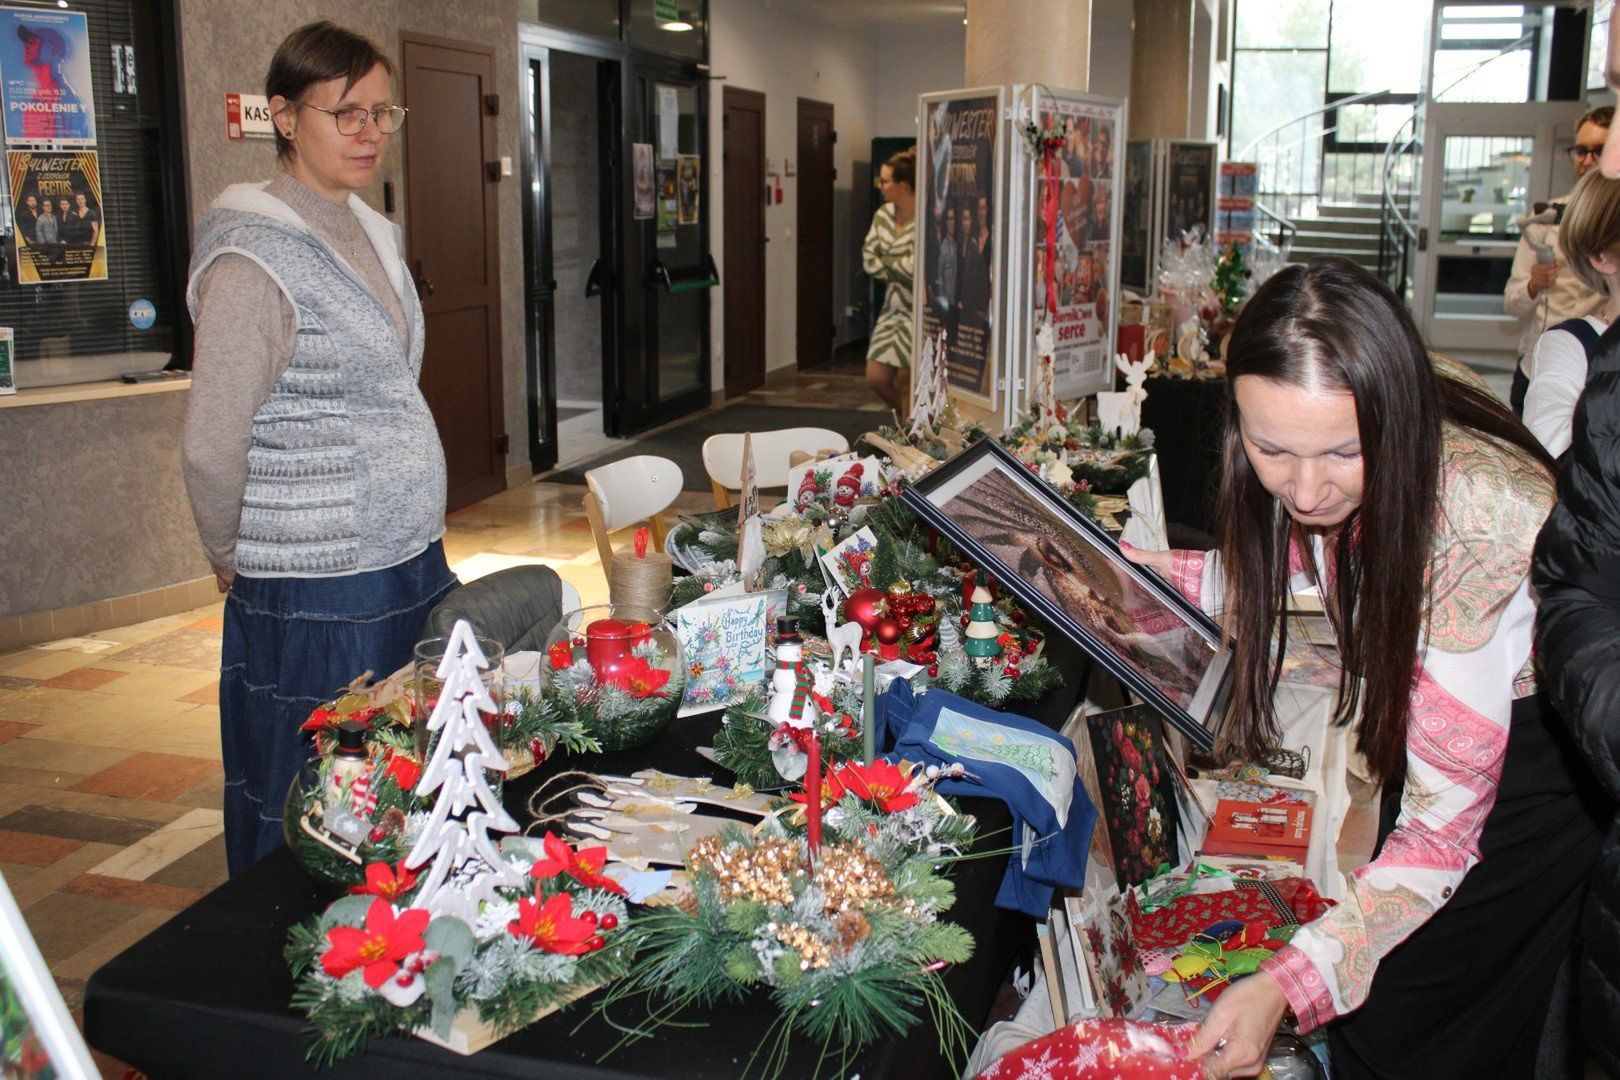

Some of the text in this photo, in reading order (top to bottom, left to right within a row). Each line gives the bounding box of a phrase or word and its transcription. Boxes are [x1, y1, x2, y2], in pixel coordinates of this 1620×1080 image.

[10, 102, 87, 113] POKOLENIE Y
[244, 106, 272, 121] KAS
[20, 153, 84, 172] SYLWESTER
[38, 180, 72, 196] PECTUS
[1058, 323, 1085, 341] serce
[721, 610, 748, 629] Happy
[725, 626, 763, 645] Birthday
